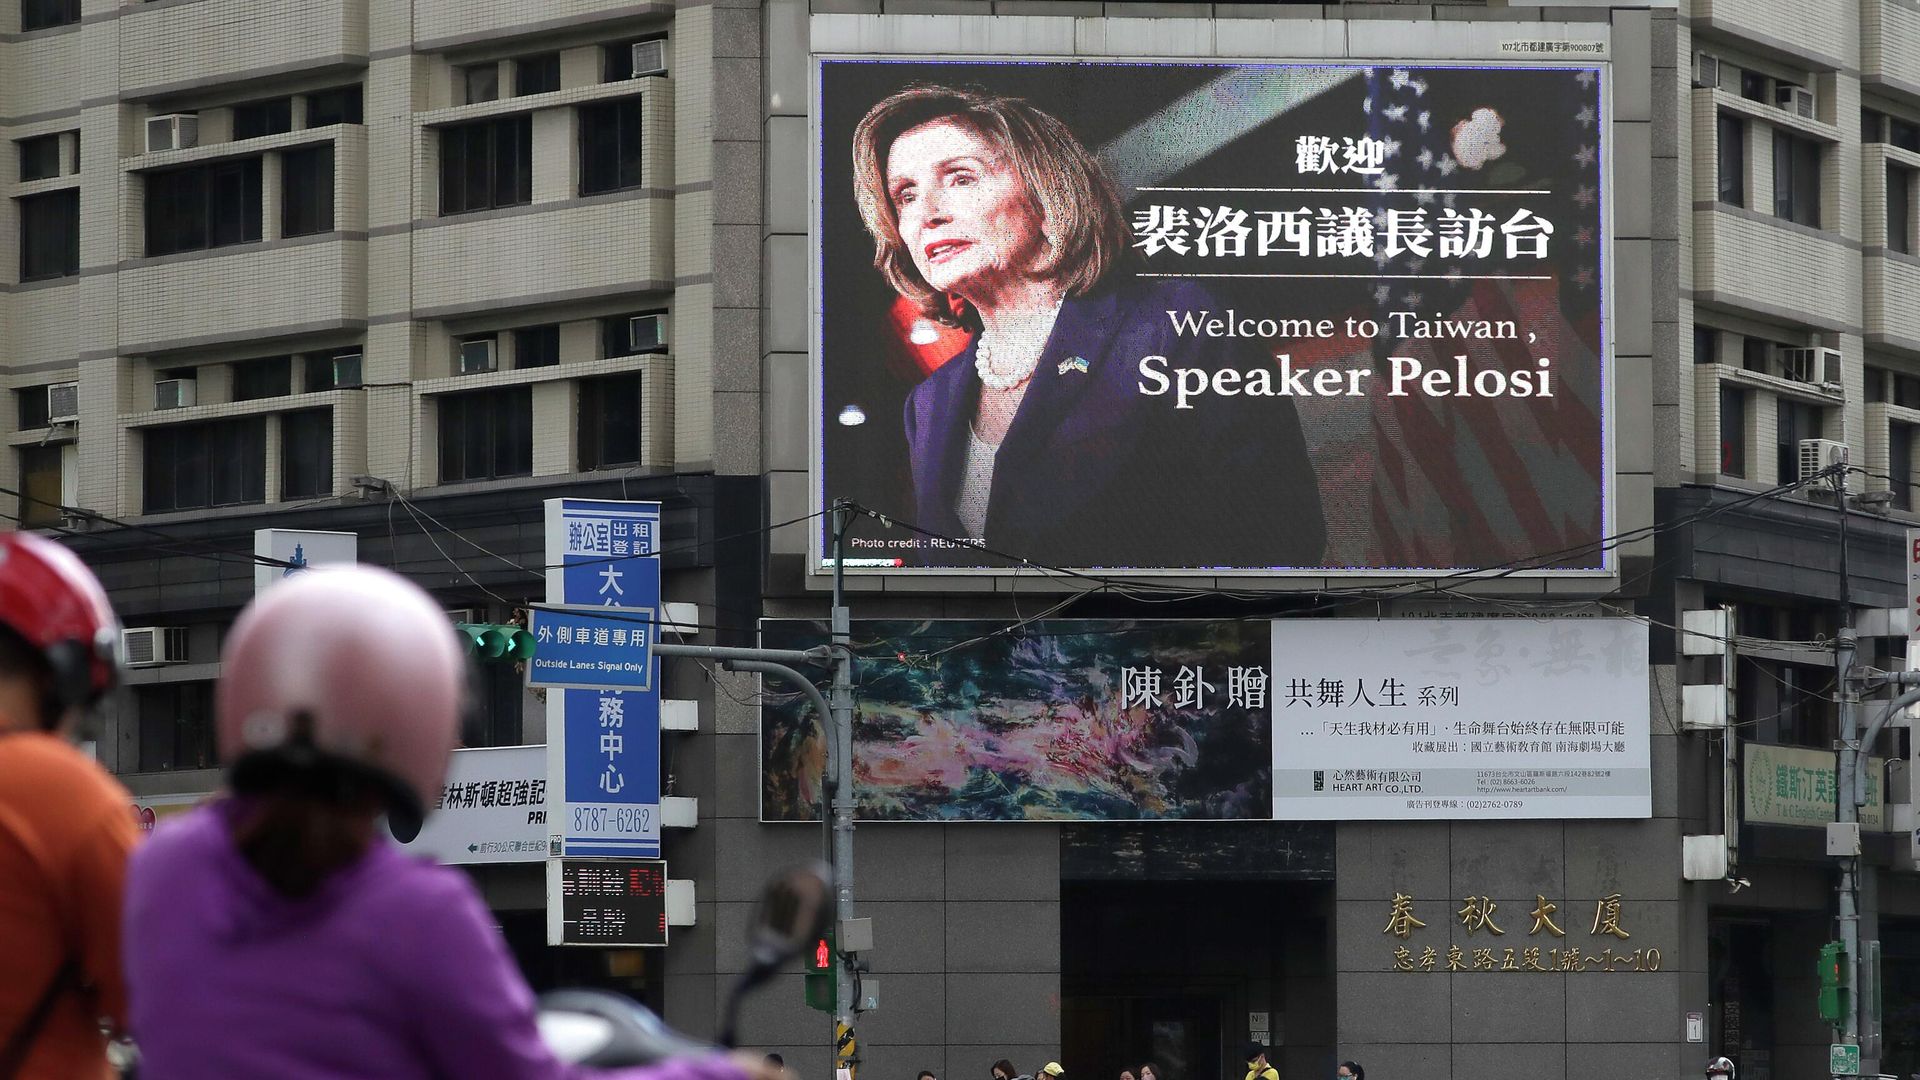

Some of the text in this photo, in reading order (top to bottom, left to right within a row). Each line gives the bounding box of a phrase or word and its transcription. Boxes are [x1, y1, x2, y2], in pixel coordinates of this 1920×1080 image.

[1295, 135, 1385, 175] 歡迎
[1131, 205, 1555, 260] 裴洛西議長訪台
[1166, 310, 1335, 339] Welcome
[1345, 316, 1379, 339] to
[1137, 353, 1554, 409] Speaker Pelosi
[569, 522, 609, 552] 辦公室
[851, 538, 885, 549] Photo
[887, 537, 921, 549] credit
[537, 625, 646, 648] 外側車道專用
[535, 658, 643, 673] Outside Lanes Signal Only
[1285, 677, 1459, 708] 共舞人生 系列
[1332, 783, 1363, 791] HEART
[1365, 783, 1383, 791] ART
[1333, 769, 1421, 783] 心然藝術有限公司
[527, 811, 547, 825] PRI
[574, 807, 650, 833] 8787-6262
